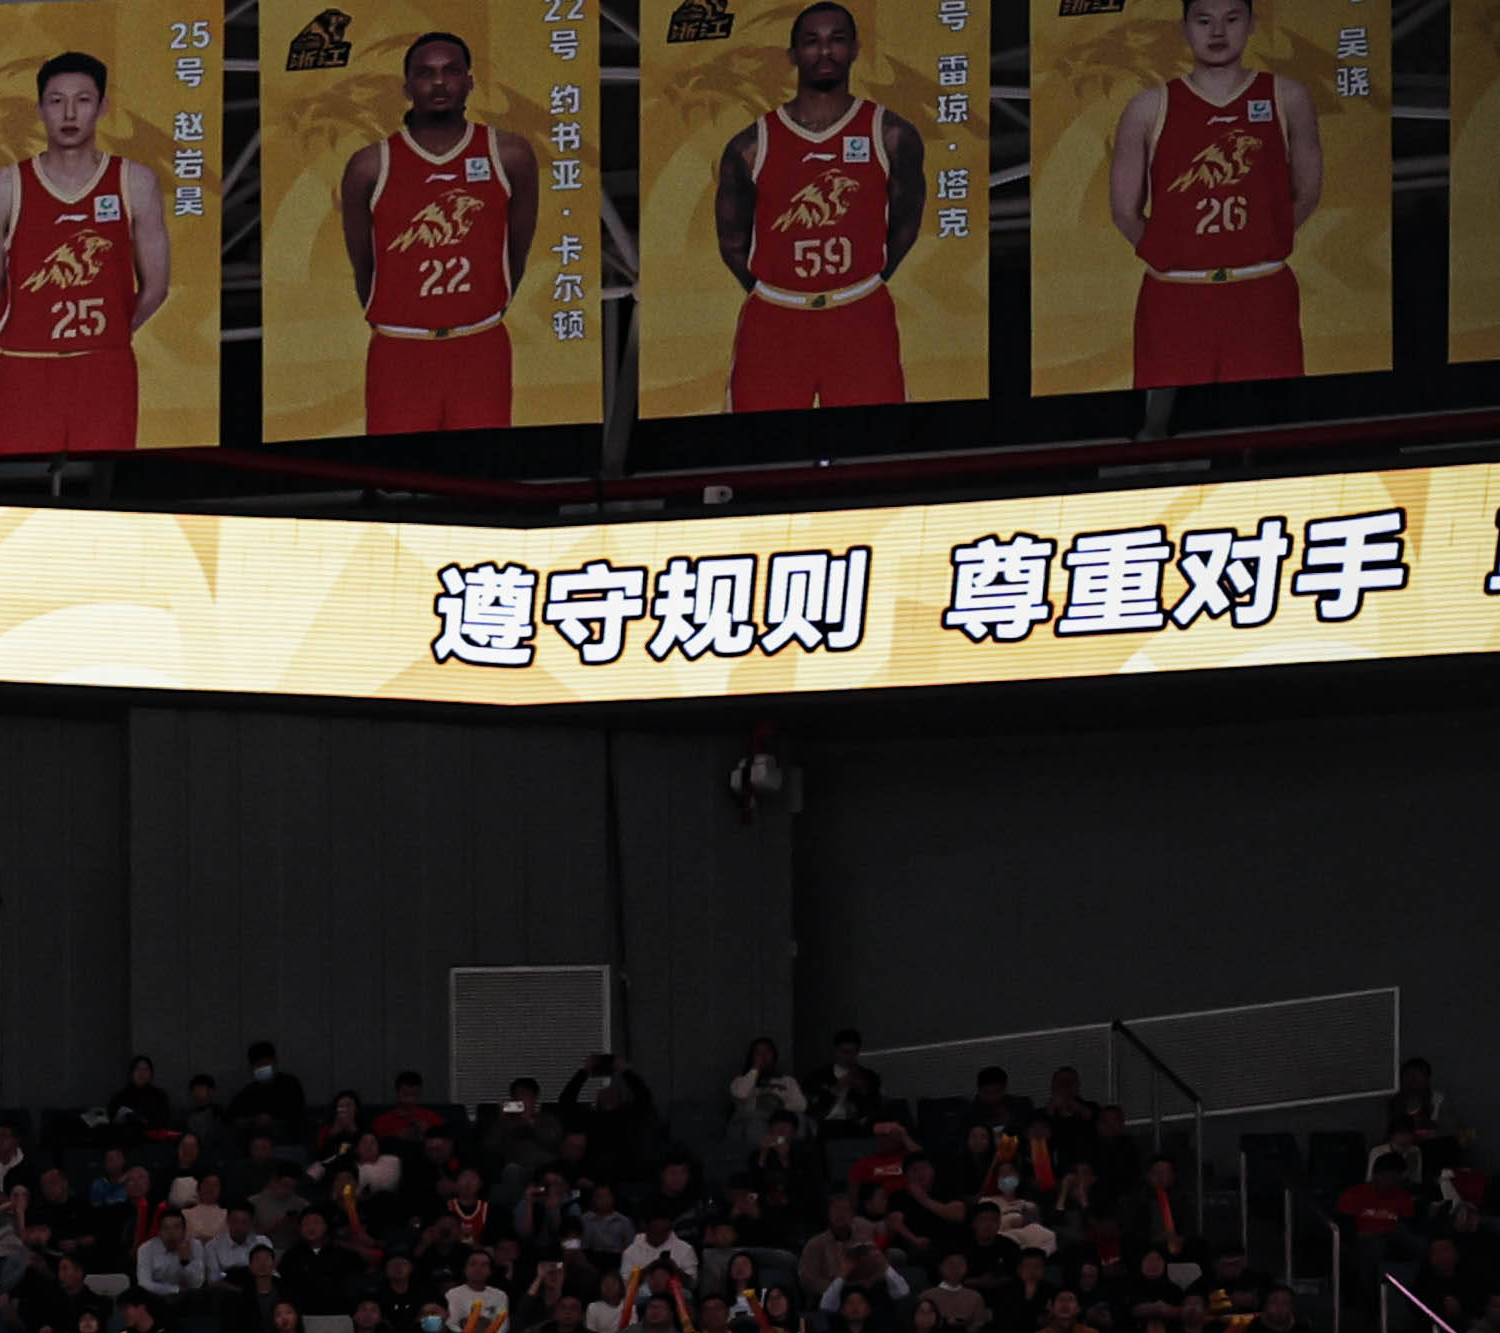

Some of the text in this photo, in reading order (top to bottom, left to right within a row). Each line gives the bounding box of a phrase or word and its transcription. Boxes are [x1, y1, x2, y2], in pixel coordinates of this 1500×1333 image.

[1336, 28, 1369, 97] 吴骁
[170, 21, 211, 215] 25号 赵岩昊
[937, 55, 969, 238] 雷琼·塔克
[551, 85, 584, 340] 约书亚·卡尔顿
[1196, 196, 1247, 234] 26
[419, 256, 471, 296] 22
[794, 236, 852, 278] 59
[51, 298, 107, 339] 25
[431, 507, 1408, 667] 遵守规则 尊重对手
